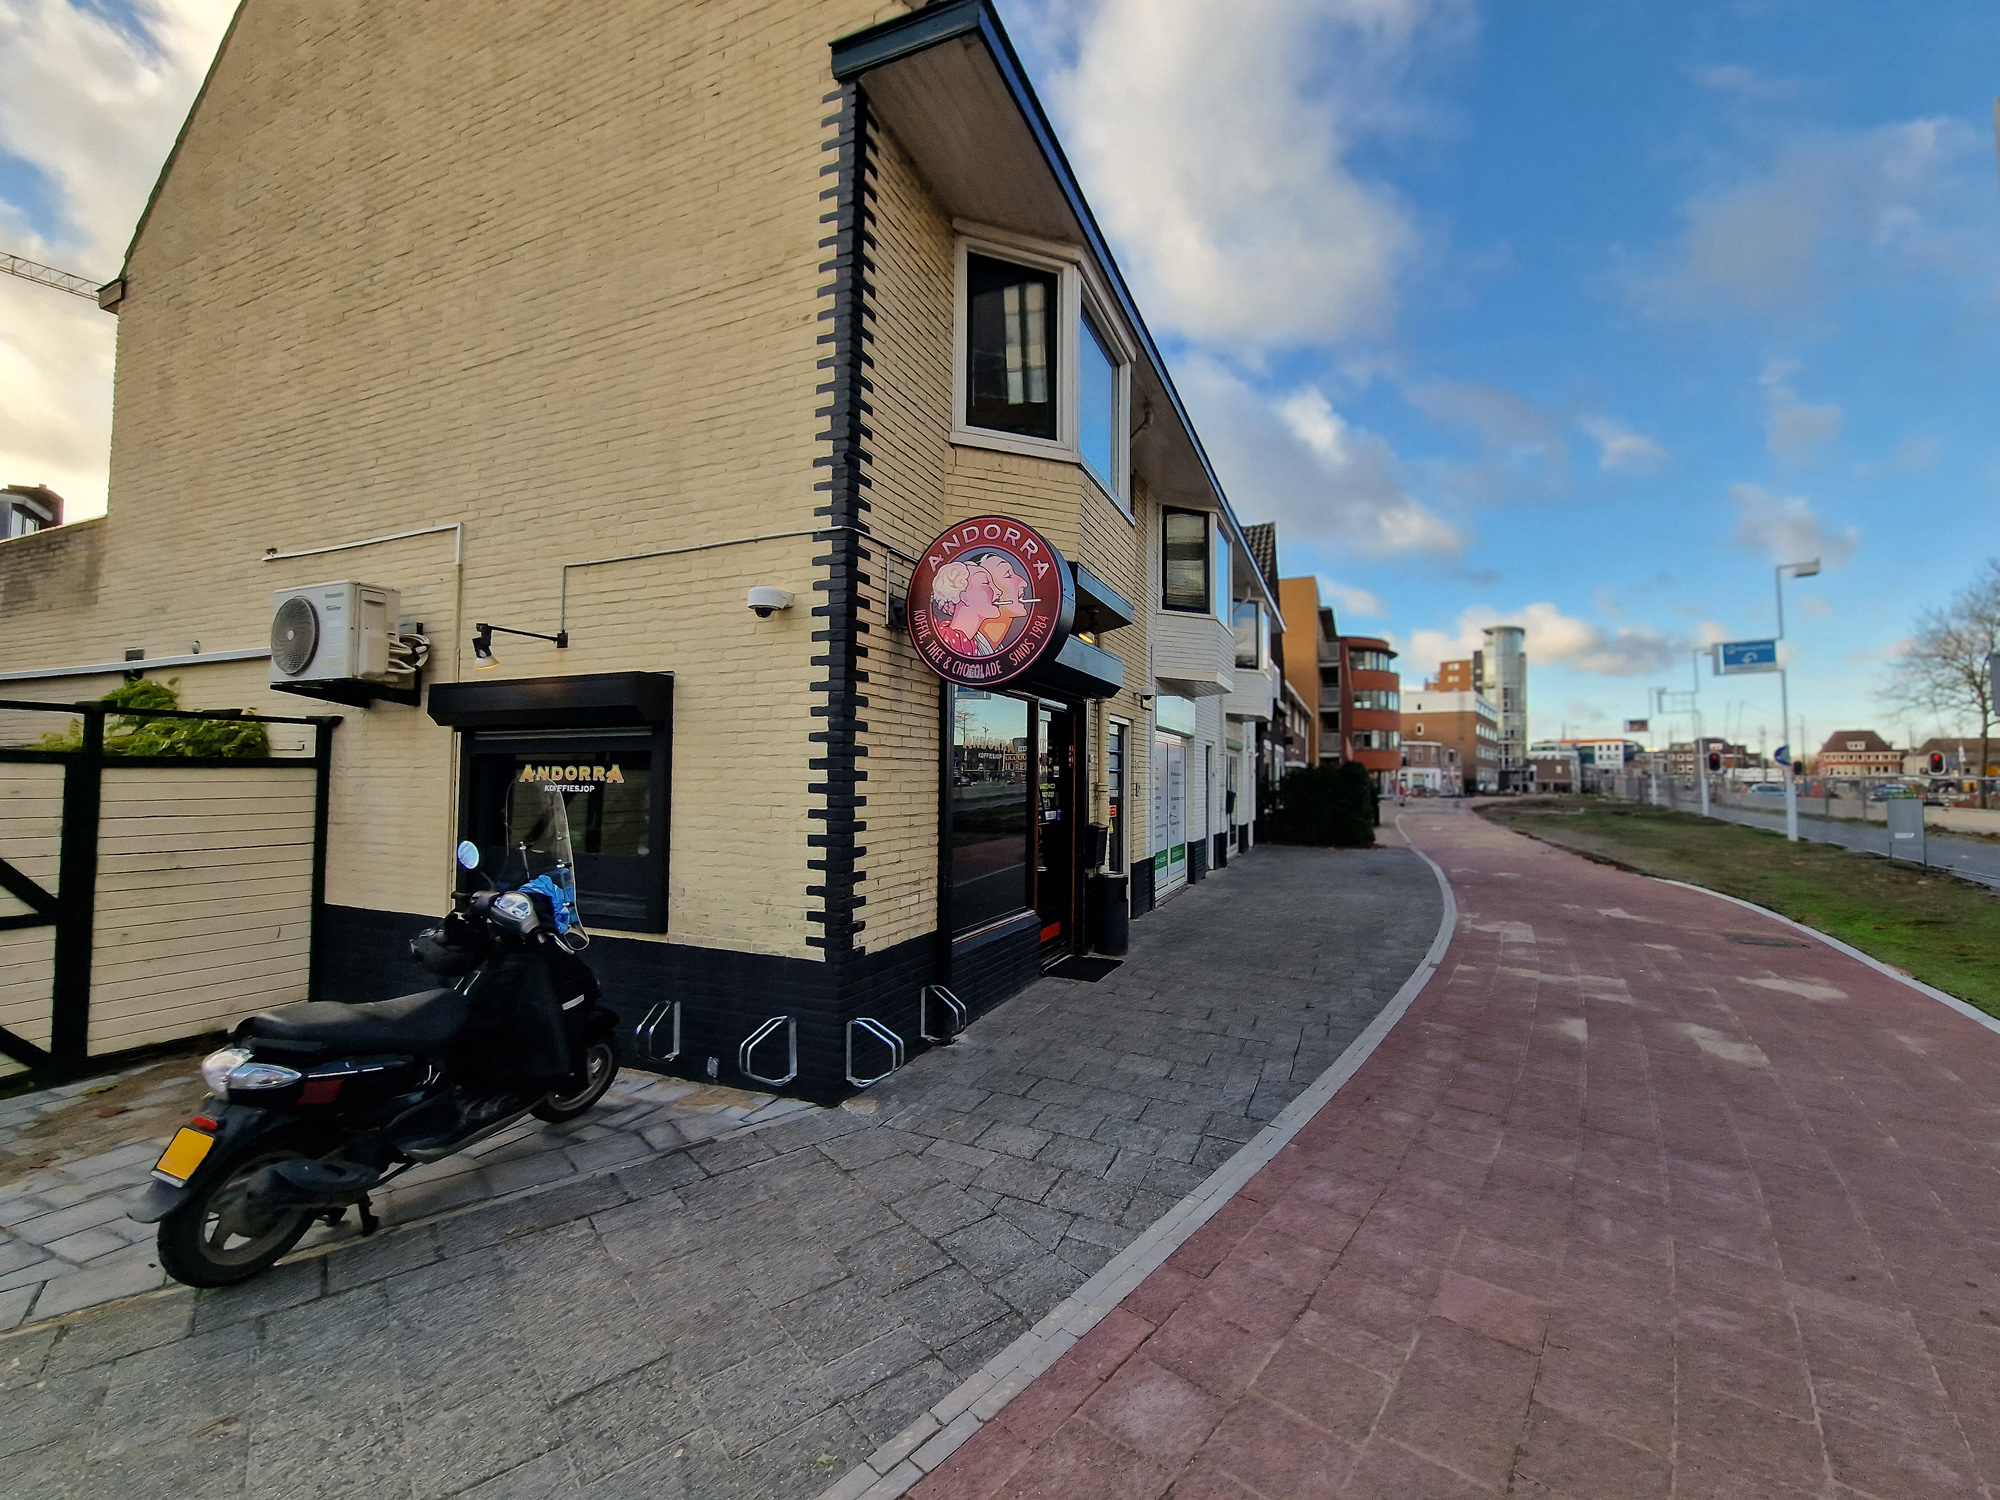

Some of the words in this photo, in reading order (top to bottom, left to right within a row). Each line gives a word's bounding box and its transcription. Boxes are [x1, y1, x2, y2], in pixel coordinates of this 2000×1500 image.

[928, 524, 1050, 580] ANDORRA
[914, 609, 931, 644] KOFFIE,
[925, 639, 945, 664] THEE
[943, 656, 952, 670] &
[1009, 638, 1036, 666] SINDS
[1029, 615, 1049, 639] 1984
[519, 763, 624, 784] ANDORRA
[544, 784, 595, 793] KOFFIESJOP
